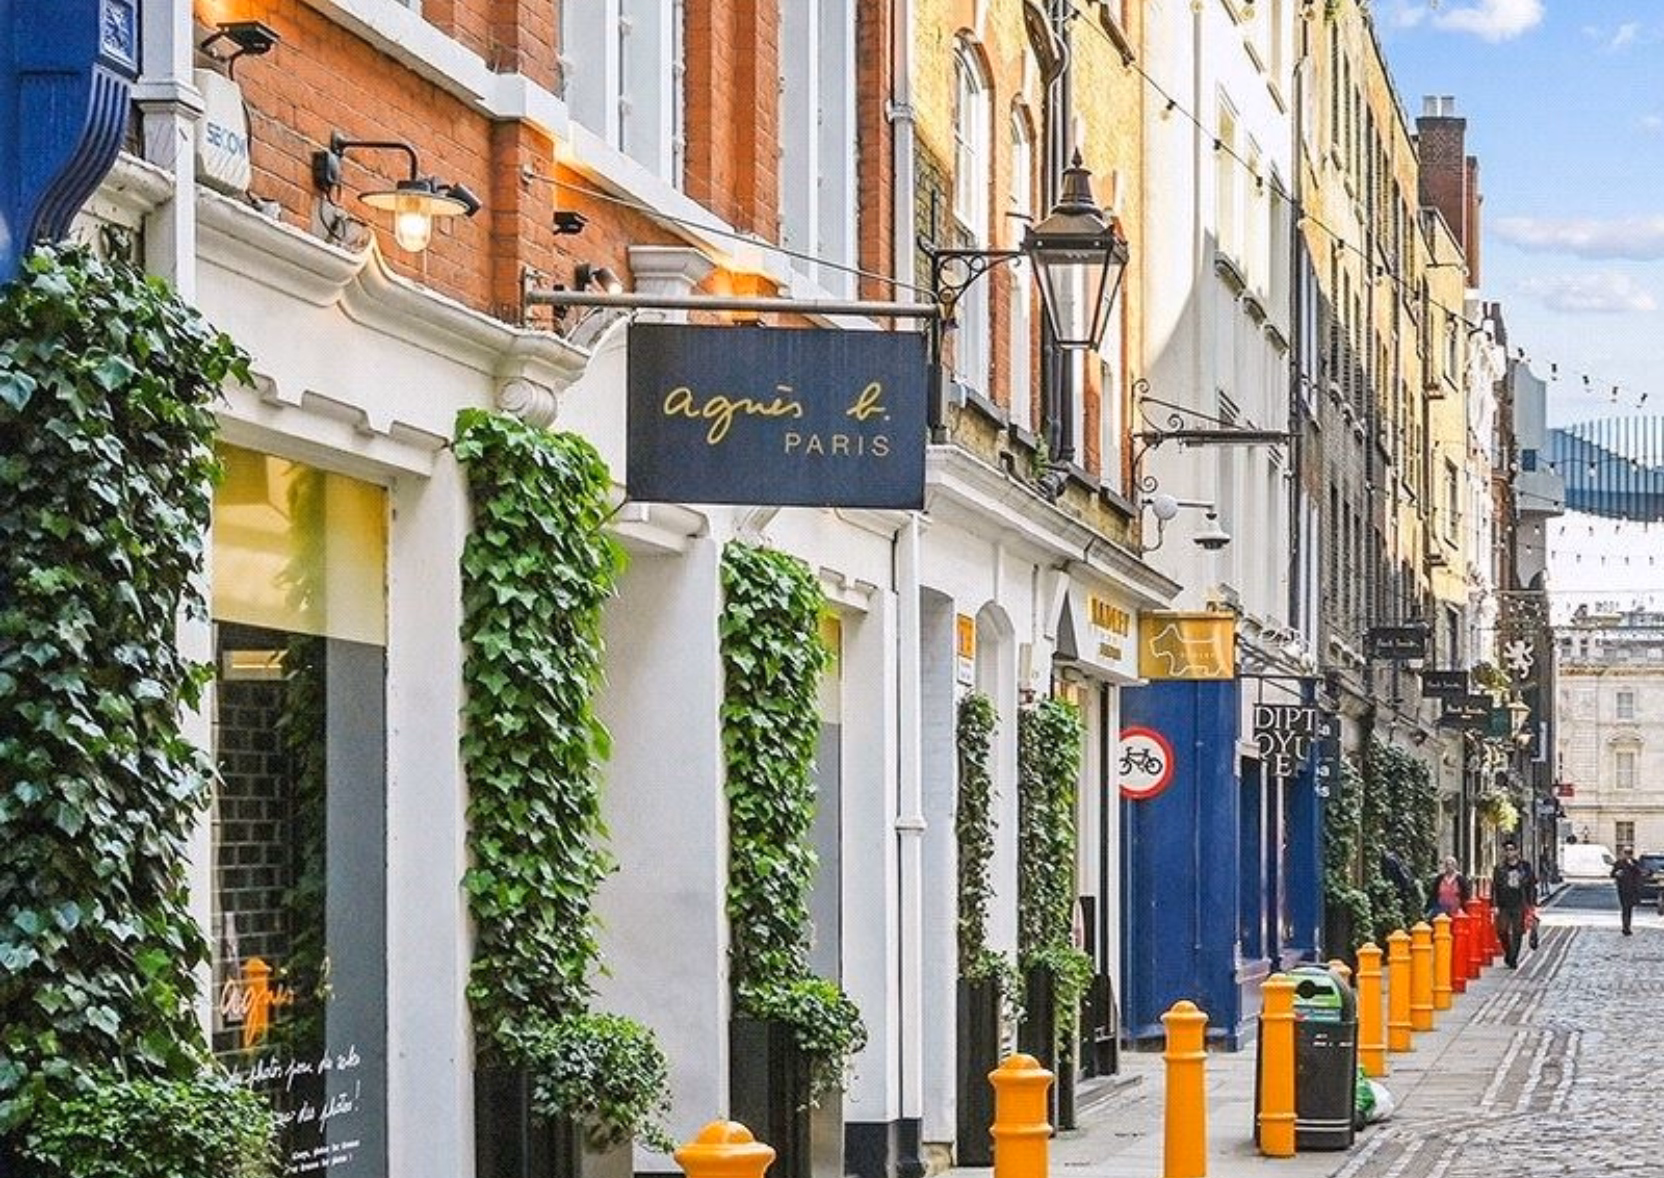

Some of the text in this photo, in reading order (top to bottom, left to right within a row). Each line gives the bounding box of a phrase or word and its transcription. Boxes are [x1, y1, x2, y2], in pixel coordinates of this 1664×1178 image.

[784, 432, 891, 457] PARIS
[1255, 706, 1315, 731] DIPT
[1273, 753, 1292, 776] E
